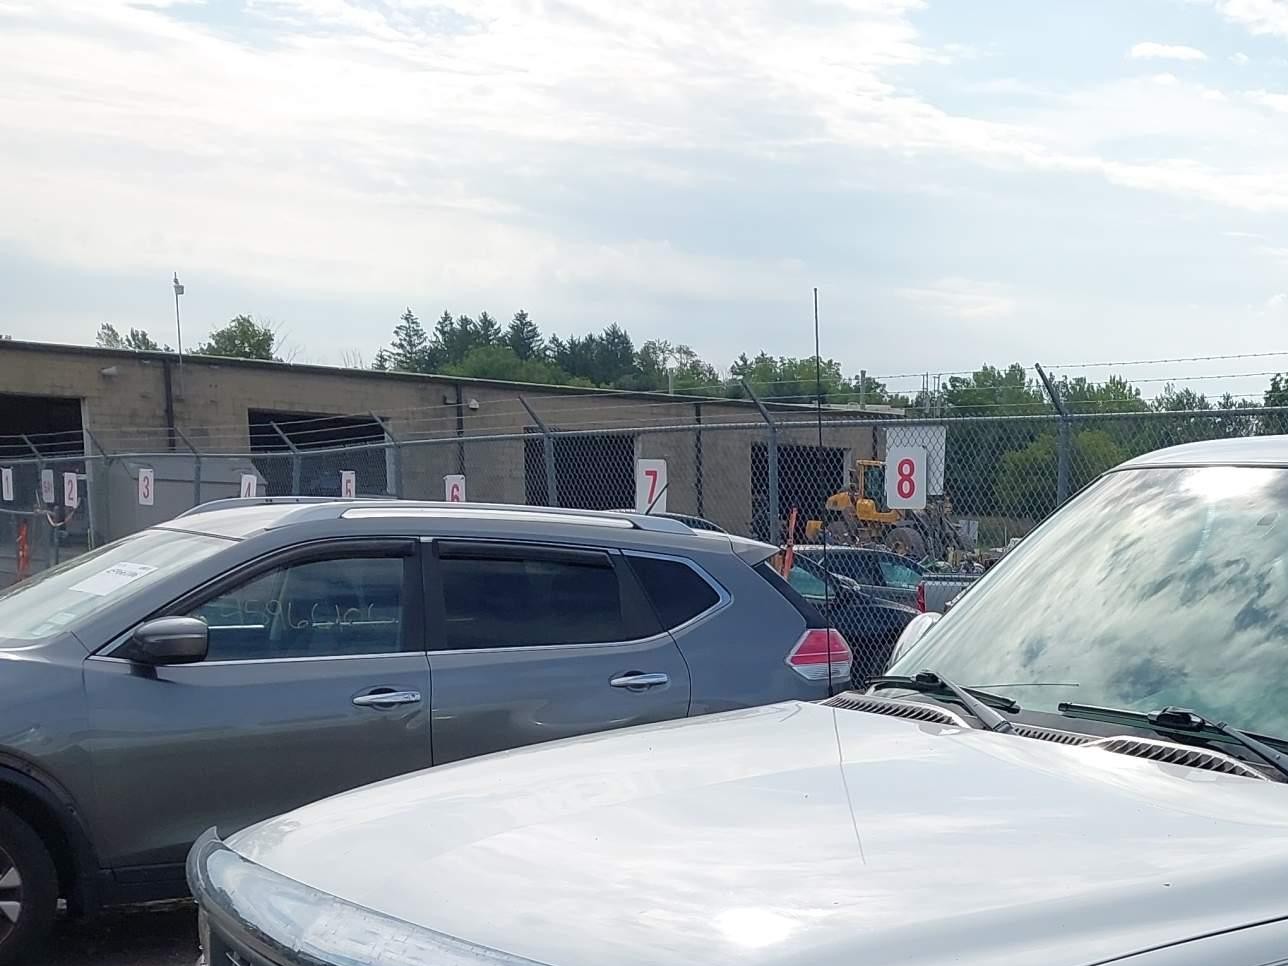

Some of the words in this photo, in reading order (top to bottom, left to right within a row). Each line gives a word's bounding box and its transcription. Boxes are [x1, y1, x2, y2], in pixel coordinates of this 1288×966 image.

[67, 479, 75, 501] 2
[142, 475, 150, 499] 3
[645, 470, 658, 504] 7
[897, 458, 915, 499] 8
[451, 483, 460, 502] 6
